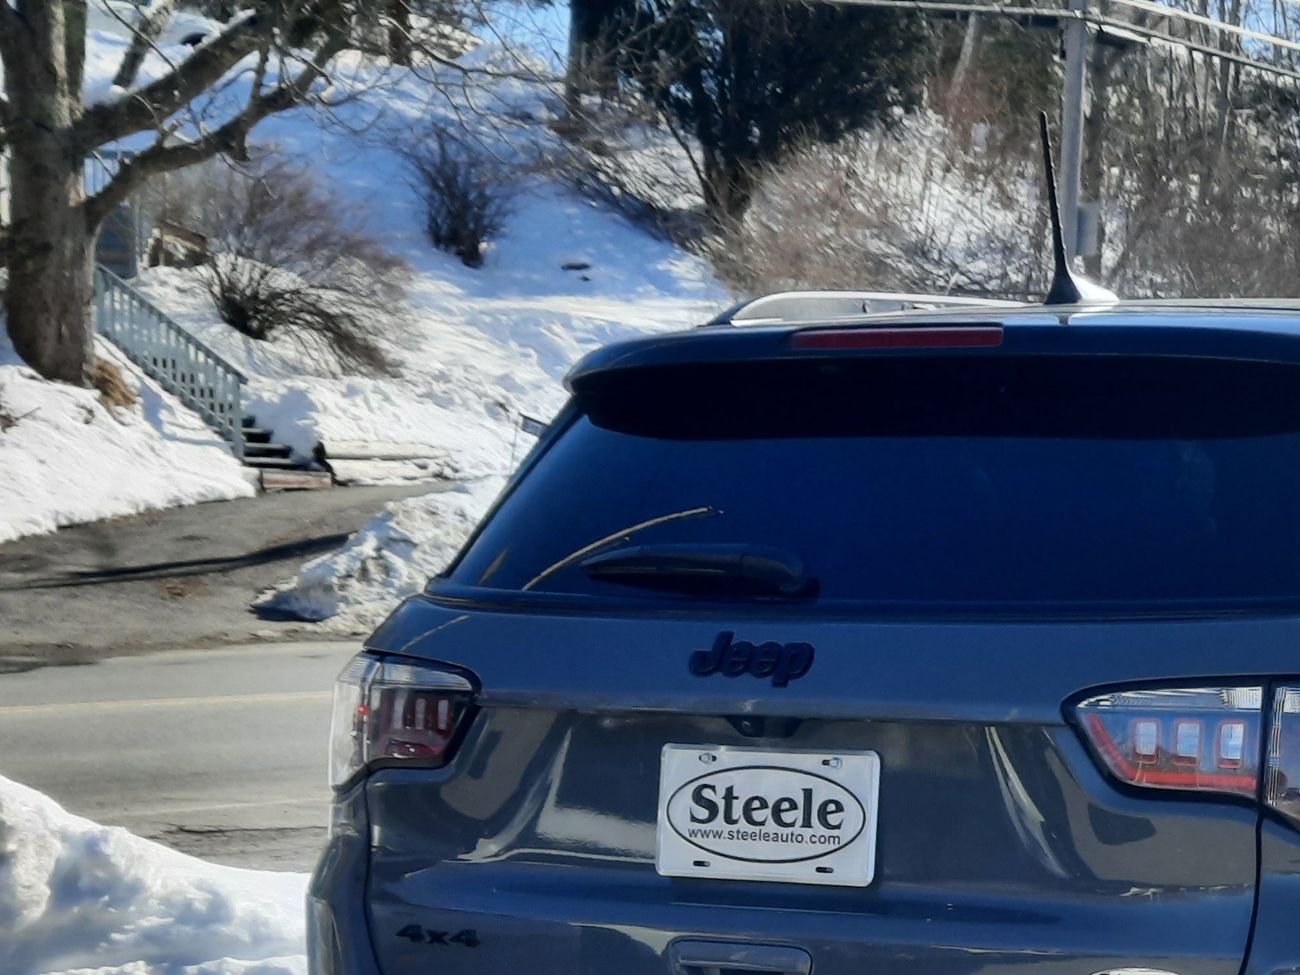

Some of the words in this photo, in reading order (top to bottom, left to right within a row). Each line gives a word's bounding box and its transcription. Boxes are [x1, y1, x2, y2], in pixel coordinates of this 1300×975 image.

[688, 630, 815, 688] Jeep
[689, 783, 845, 830] Steele
[688, 828, 841, 846] www.steeleauto.com
[395, 924, 480, 948] 4x4
